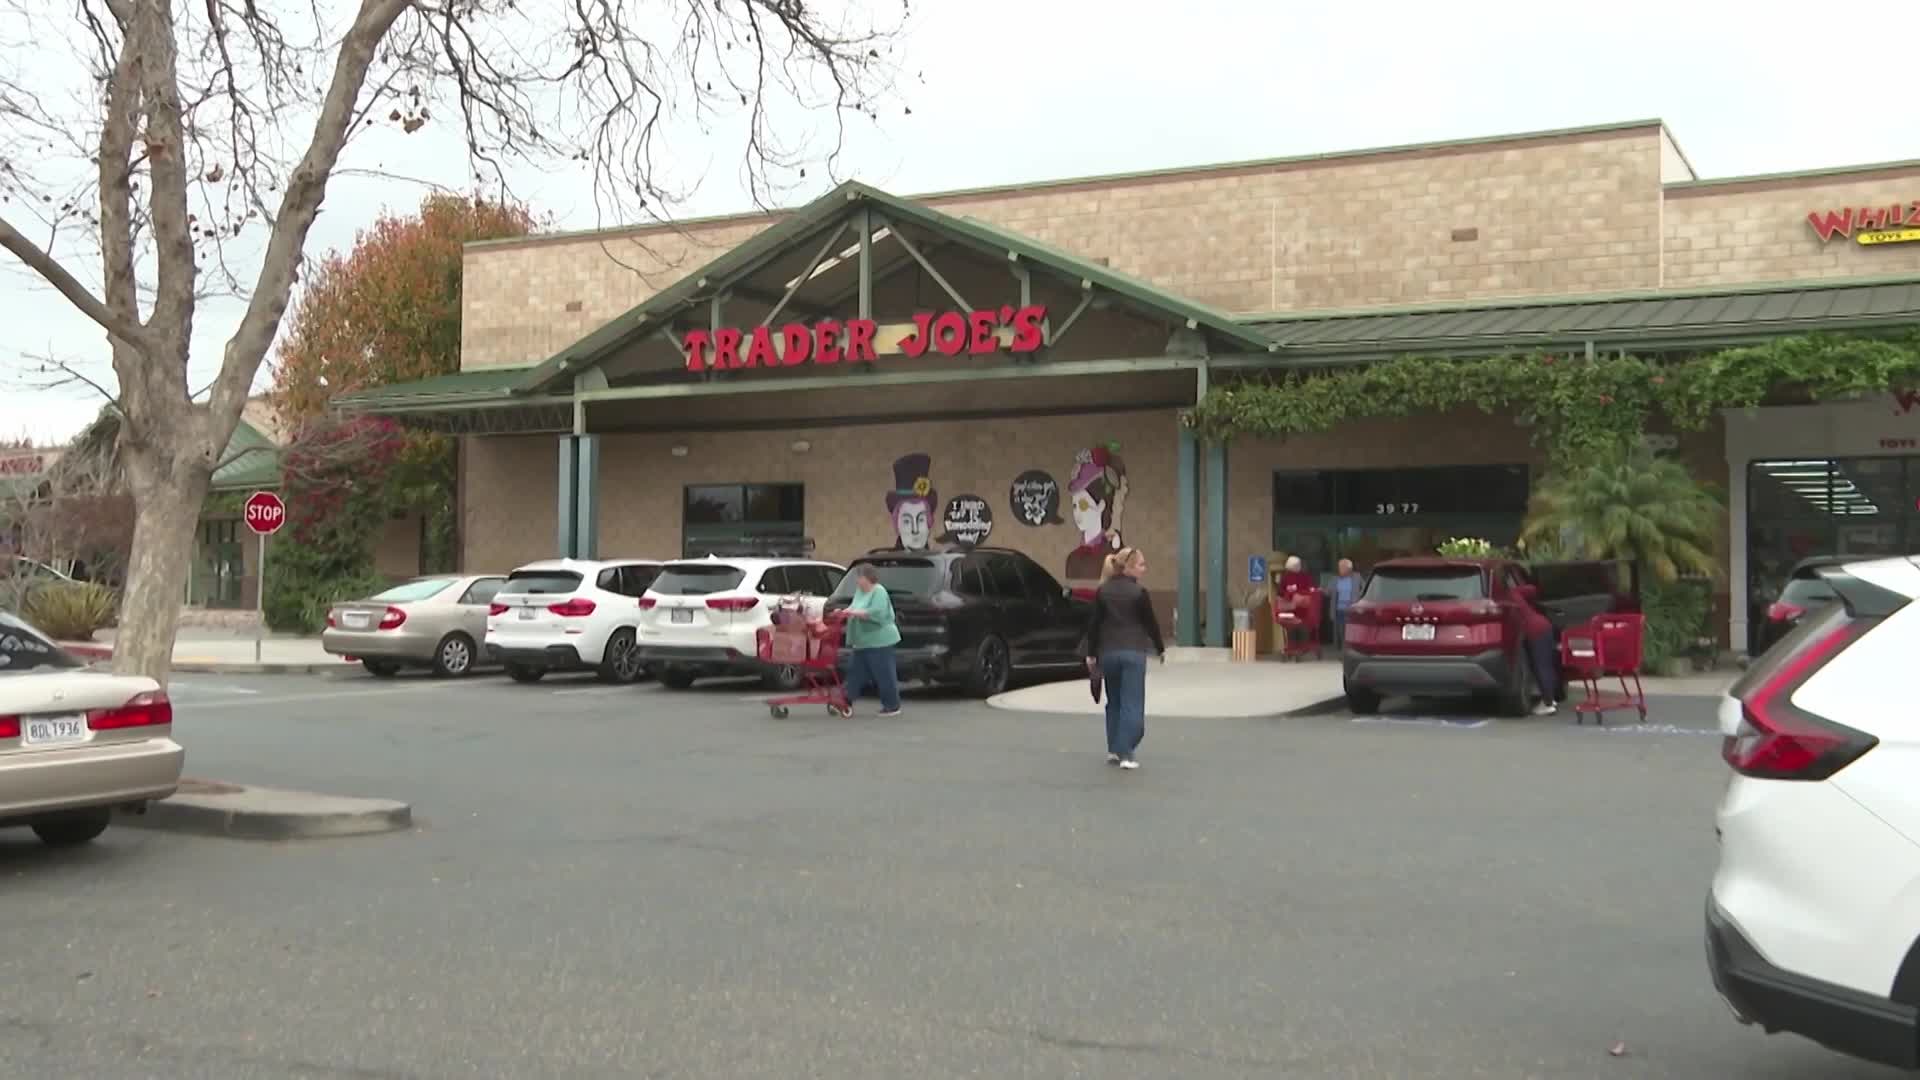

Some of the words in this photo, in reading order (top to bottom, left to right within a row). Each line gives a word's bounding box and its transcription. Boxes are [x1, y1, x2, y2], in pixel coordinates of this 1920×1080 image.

[1869, 231, 1902, 241] TOYS
[684, 319, 879, 371] TRADER
[897, 304, 1047, 358] JOE'S
[248, 504, 282, 521] STOP
